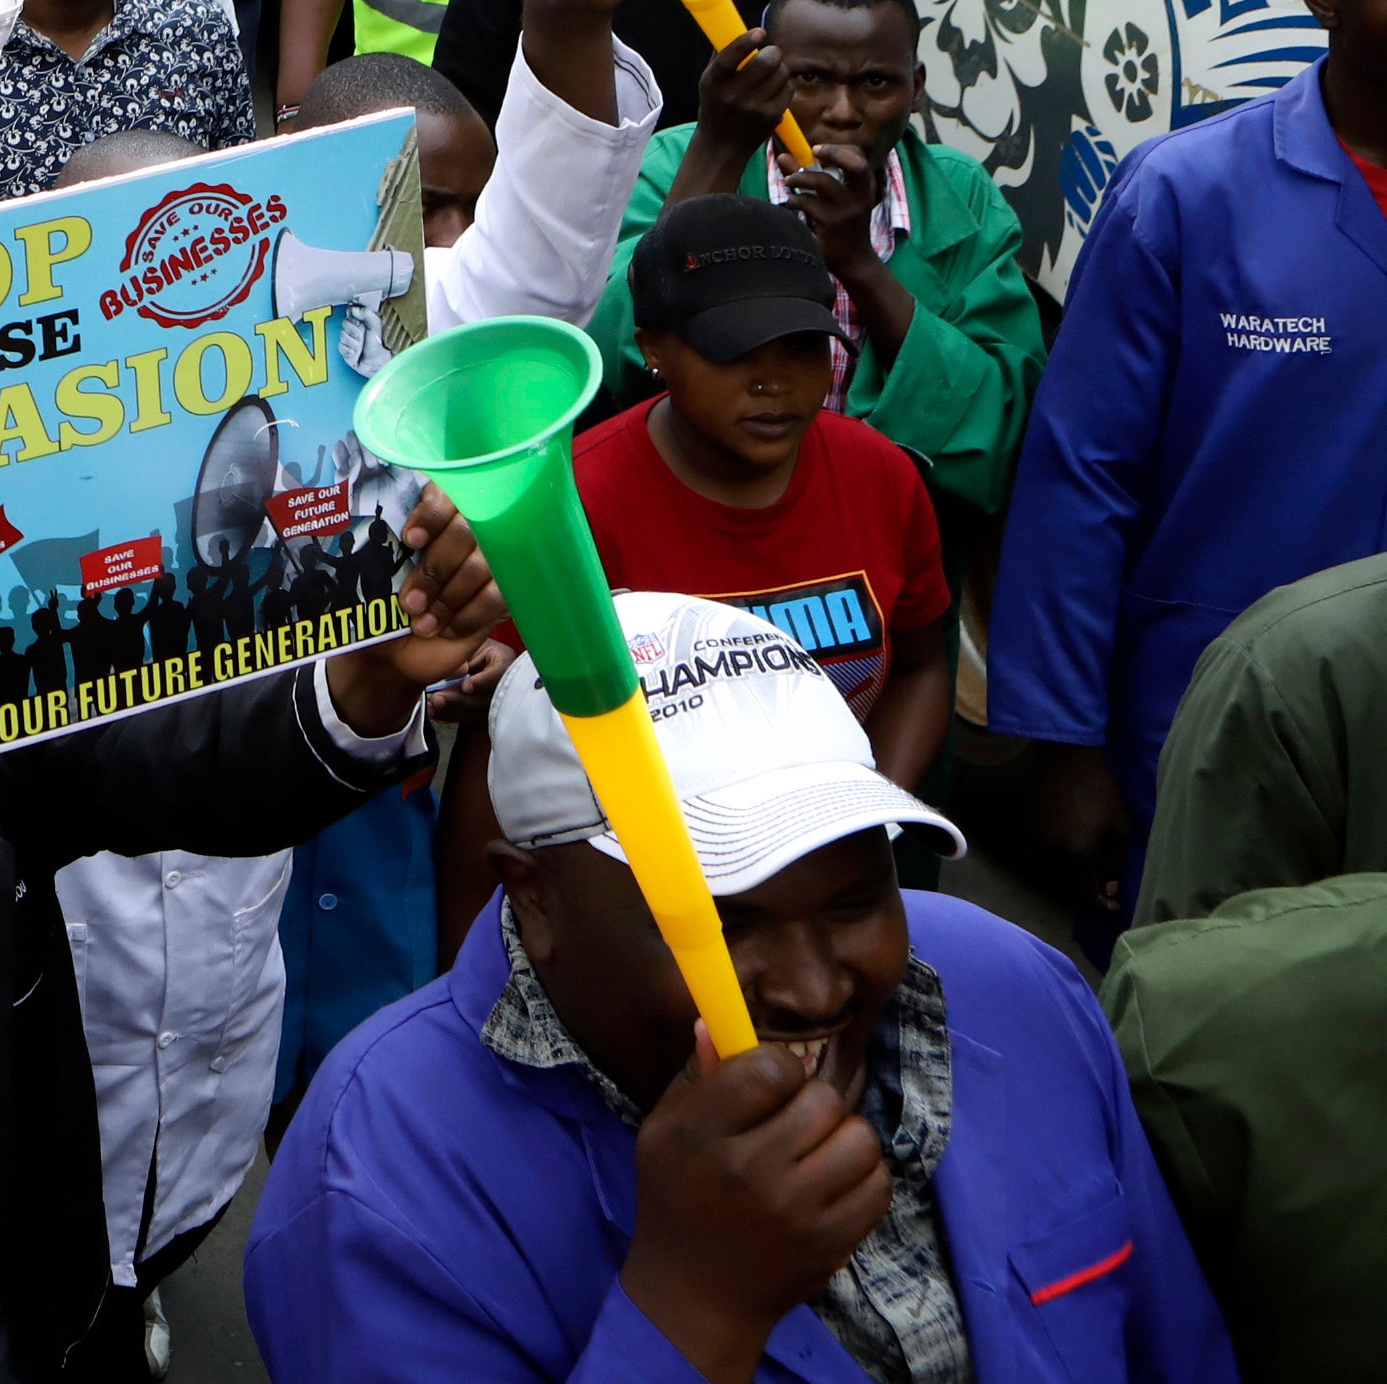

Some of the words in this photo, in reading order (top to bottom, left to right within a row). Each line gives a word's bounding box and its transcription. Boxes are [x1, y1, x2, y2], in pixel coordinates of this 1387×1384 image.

[142, 211, 181, 264] SAVE
[188, 202, 233, 221] OUR
[98, 194, 288, 322] BUSINESSES
[1220, 313, 1327, 334] WARATECH
[1226, 332, 1333, 355] HARDWARE
[287, 493, 315, 509] SAVE
[318, 485, 341, 499] OUR
[294, 501, 336, 521] FUTURE
[282, 511, 349, 538] GENERATION
[103, 549, 135, 565] SAVE
[107, 561, 133, 575] OUR
[86, 564, 159, 591] BUSINESSES
[78, 651, 204, 719] FUTURE
[213, 593, 413, 678] GENERATION
[628, 641, 666, 664] NFL
[638, 642, 824, 705] HAMPIONS
[648, 694, 705, 723] 2010
